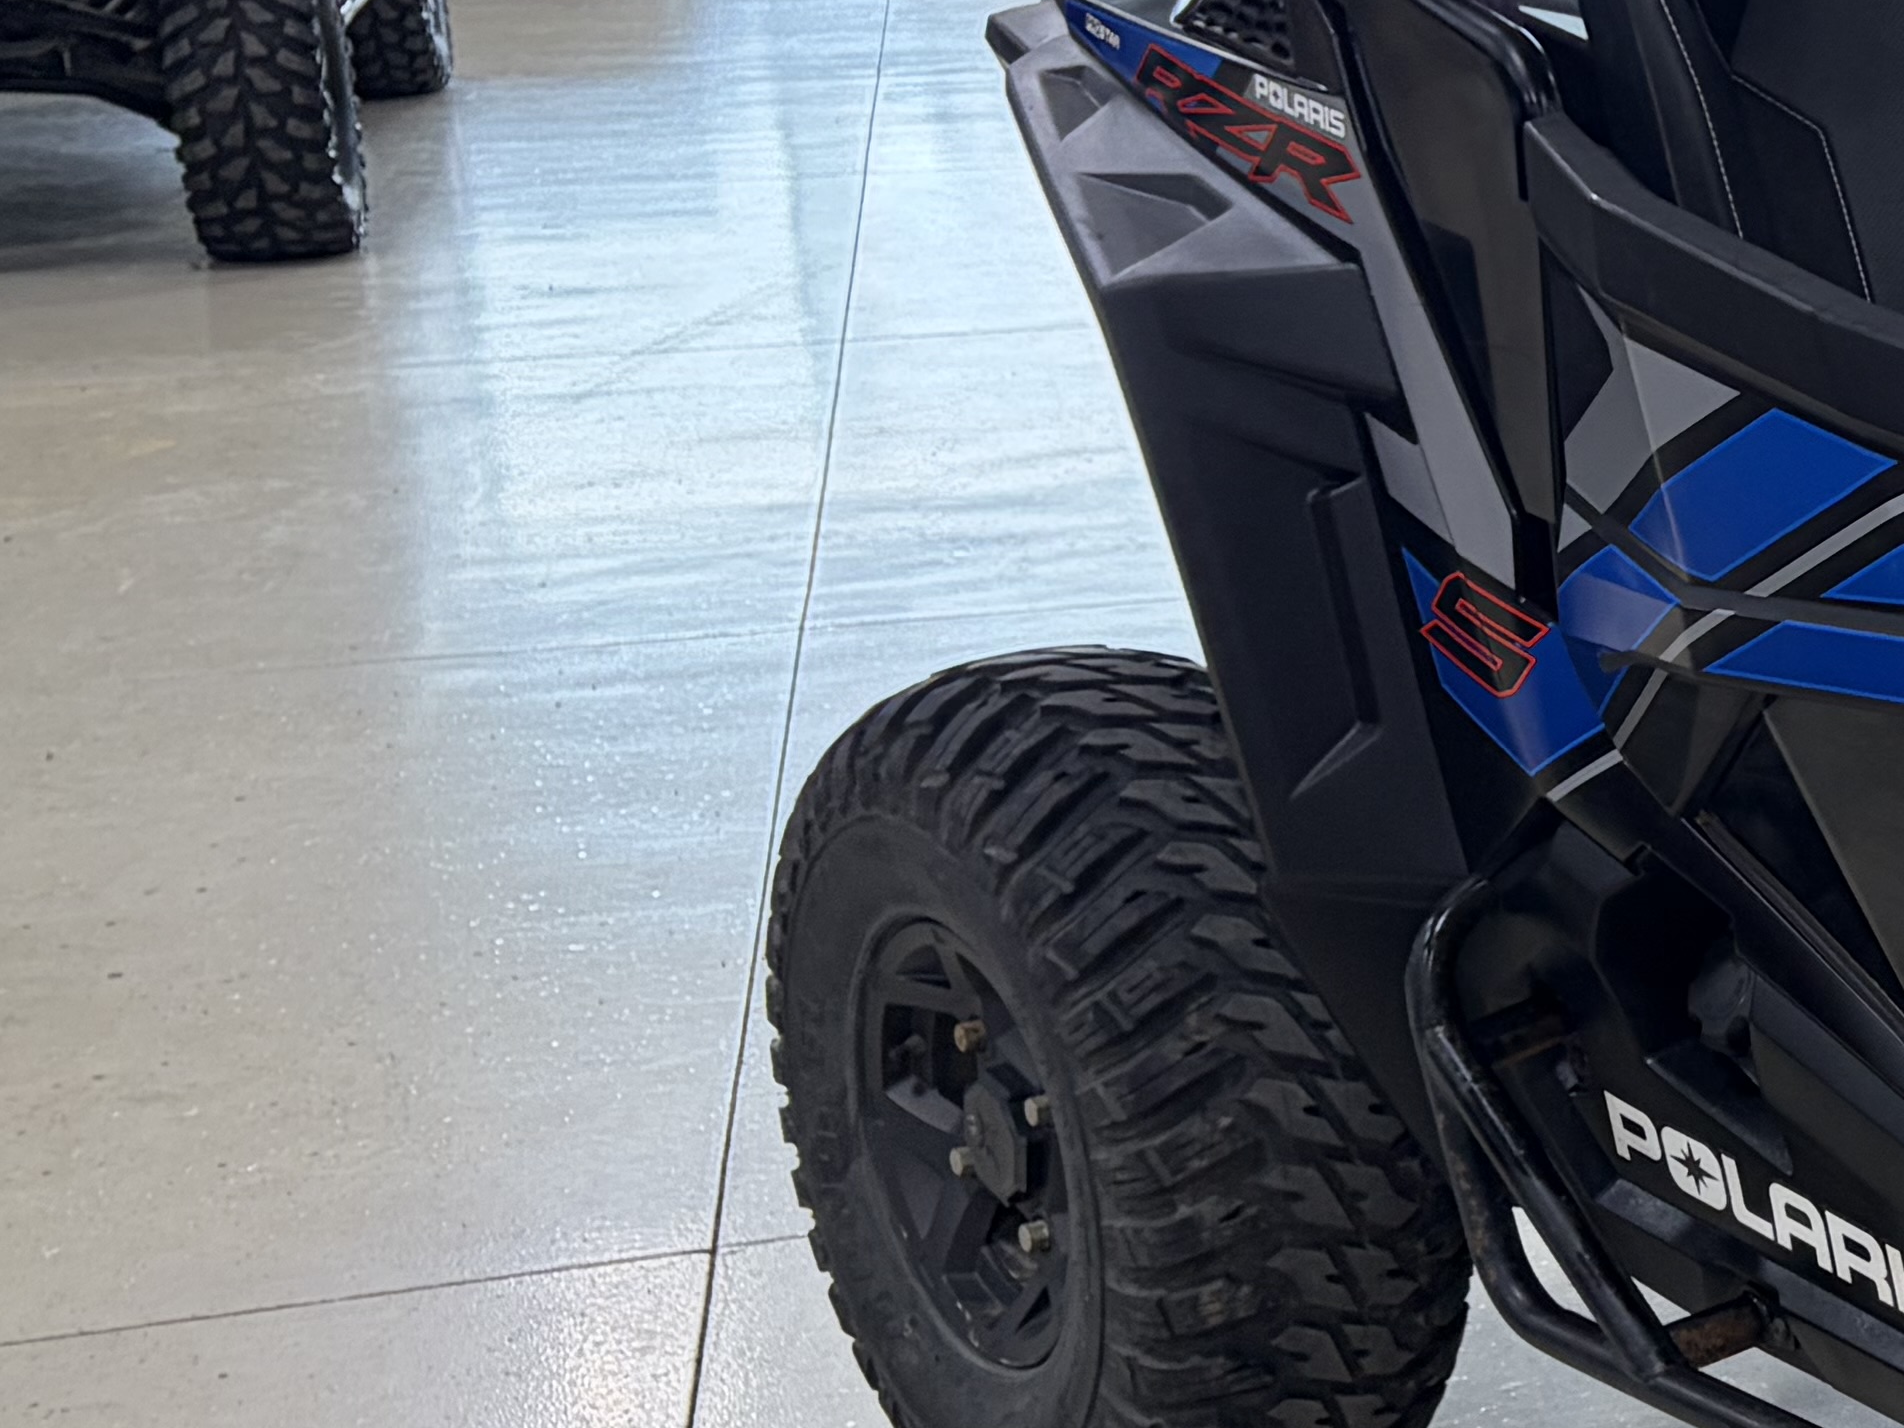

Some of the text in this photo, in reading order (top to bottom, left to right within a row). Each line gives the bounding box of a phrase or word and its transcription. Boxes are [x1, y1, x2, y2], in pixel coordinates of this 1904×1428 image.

[1131, 42, 1363, 225] RZR
[1253, 72, 1347, 140] POLARIS
[1418, 570, 1551, 699] S
